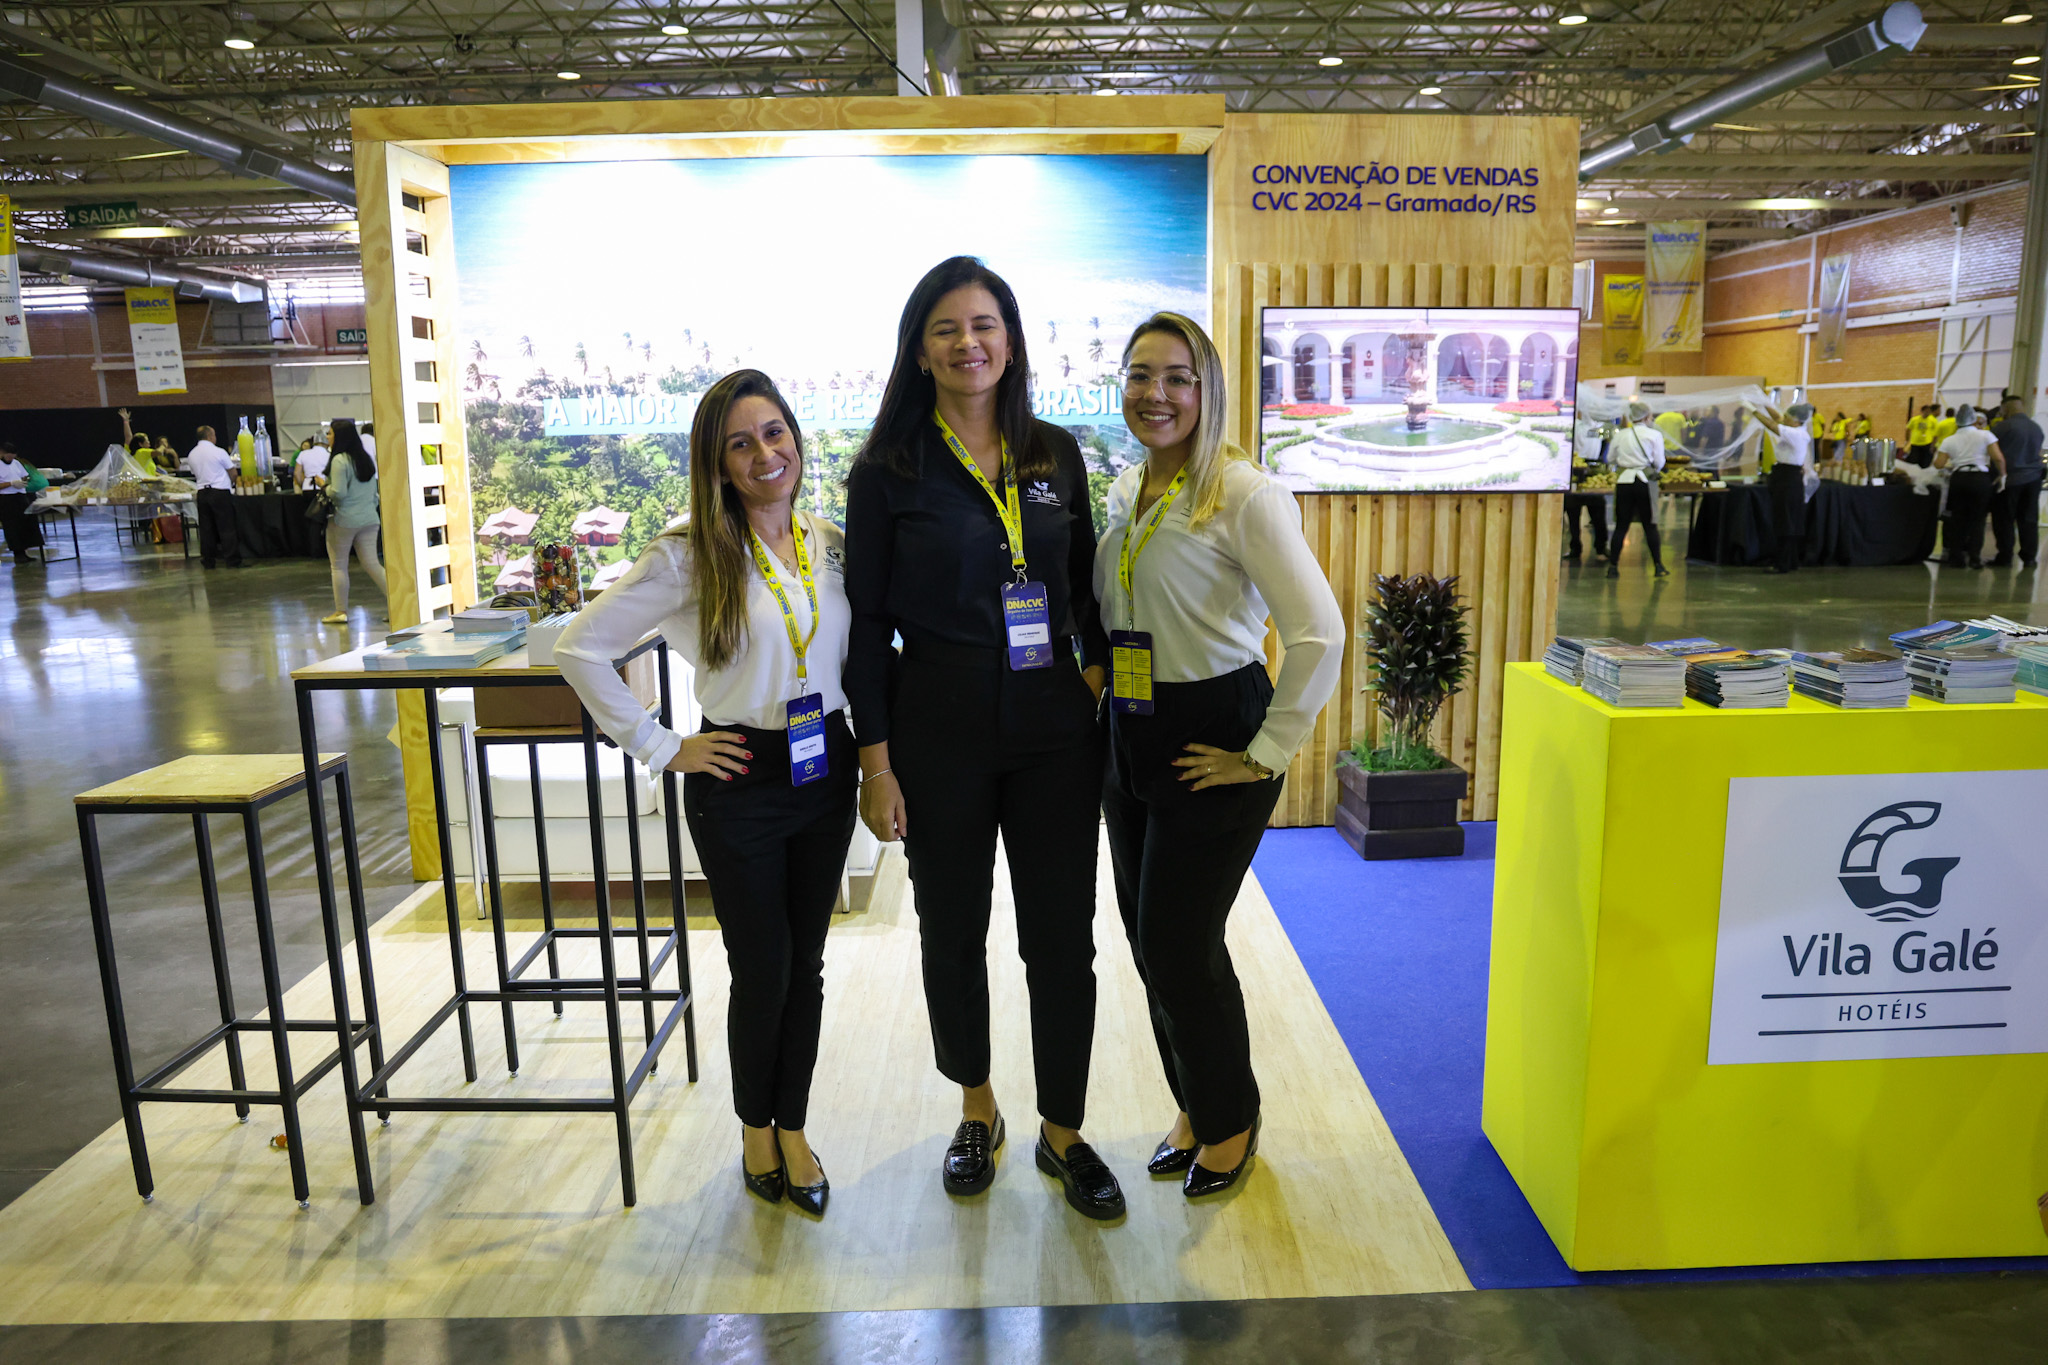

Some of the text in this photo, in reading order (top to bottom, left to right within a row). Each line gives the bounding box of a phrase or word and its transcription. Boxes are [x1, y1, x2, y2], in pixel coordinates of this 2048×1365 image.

[1252, 161, 1539, 189] CONVENÇÃO DE VENDAS
[78, 206, 129, 223] SAÍDA
[1252, 191, 1298, 211] CVC
[1305, 192, 1362, 211] 2024
[1386, 193, 1536, 216] Gramado/RS
[339, 330, 366, 342] SAÍD
[547, 394, 570, 426] A
[581, 392, 677, 425] MAIOR
[1031, 385, 1123, 417] BRASIL
[1782, 927, 1999, 977] Vila Galé
[1838, 999, 1928, 1022] HOTÉIS
